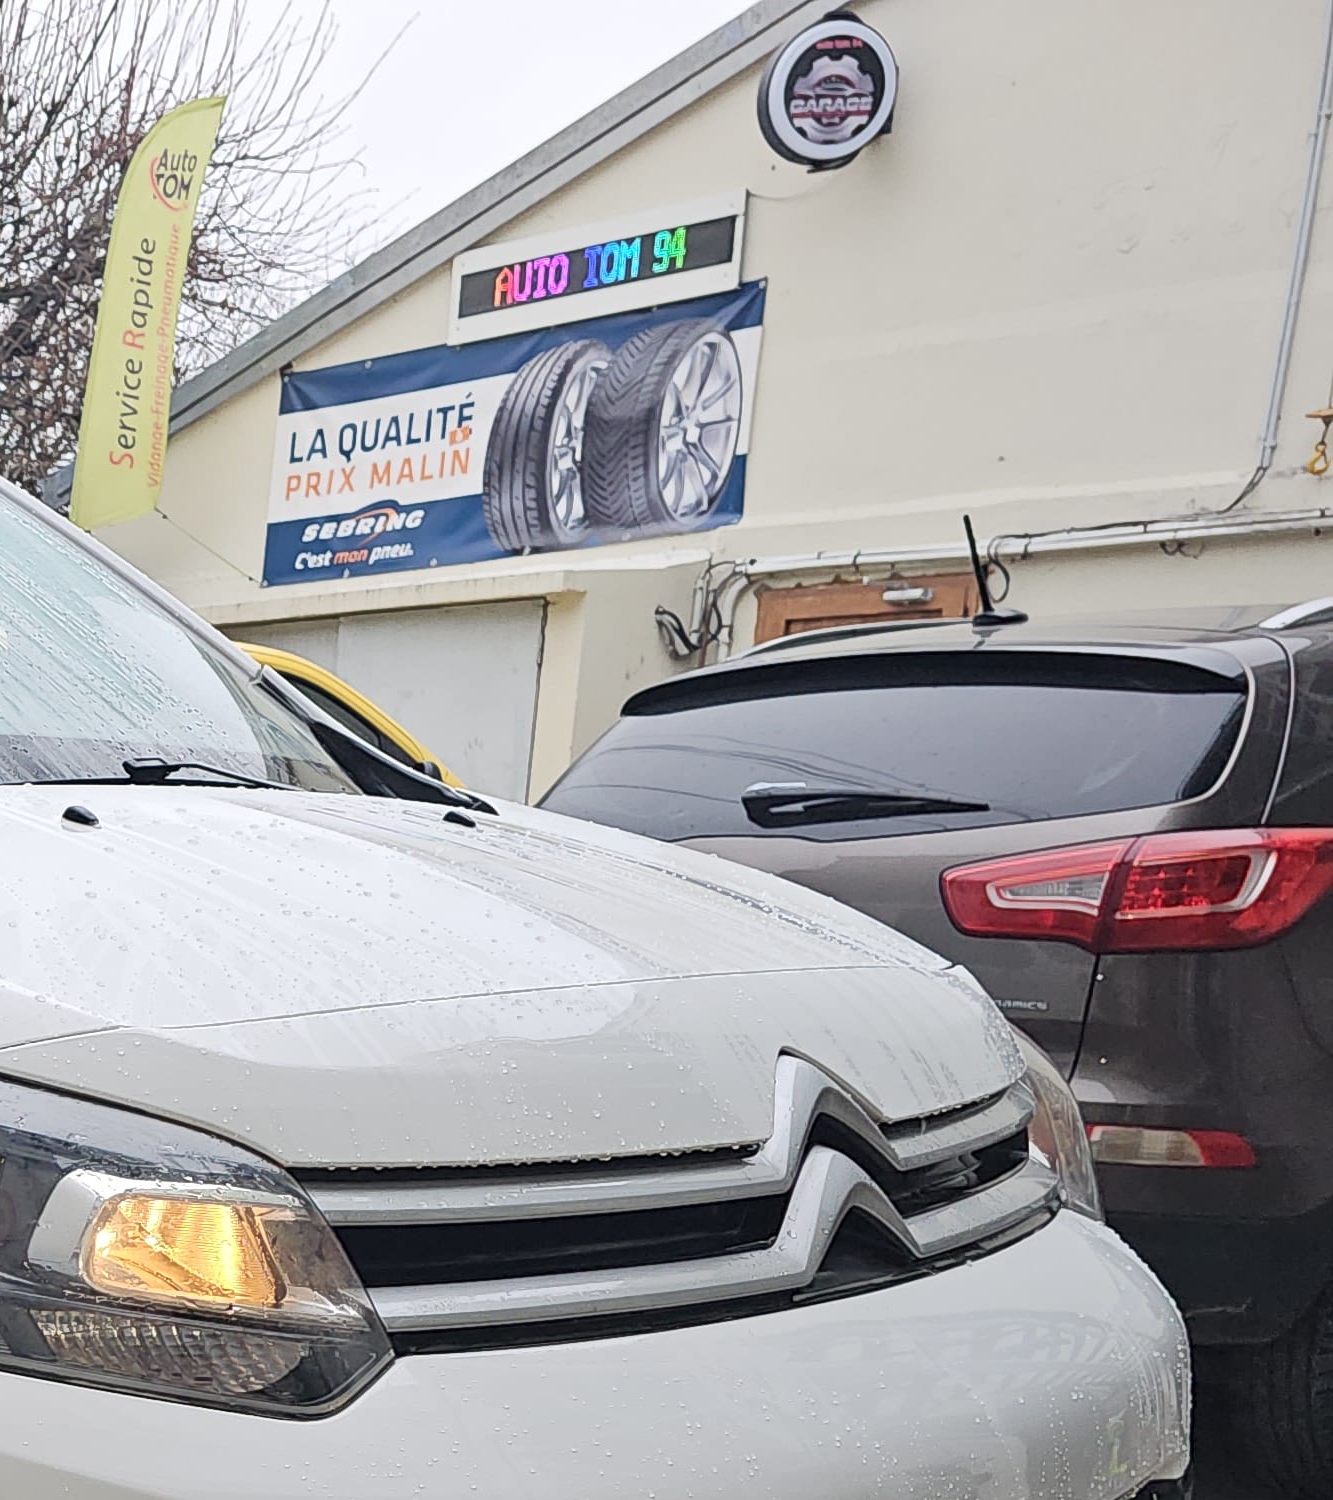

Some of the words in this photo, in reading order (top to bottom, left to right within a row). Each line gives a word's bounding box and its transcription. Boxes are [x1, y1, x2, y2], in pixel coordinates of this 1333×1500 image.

[790, 96, 874, 114] GARAGE
[156, 148, 198, 172] Auto
[154, 173, 194, 200] TOM
[652, 226, 688, 274] 94
[122, 238, 156, 350] Rapide
[109, 358, 143, 469] Service
[289, 428, 328, 465] LA
[338, 391, 475, 464] QUALITÉ
[285, 465, 356, 502] PRIX
[369, 447, 471, 490] MALIN
[301, 509, 426, 543] SEBRING
[294, 549, 333, 571] C'est
[332, 548, 369, 565] mon
